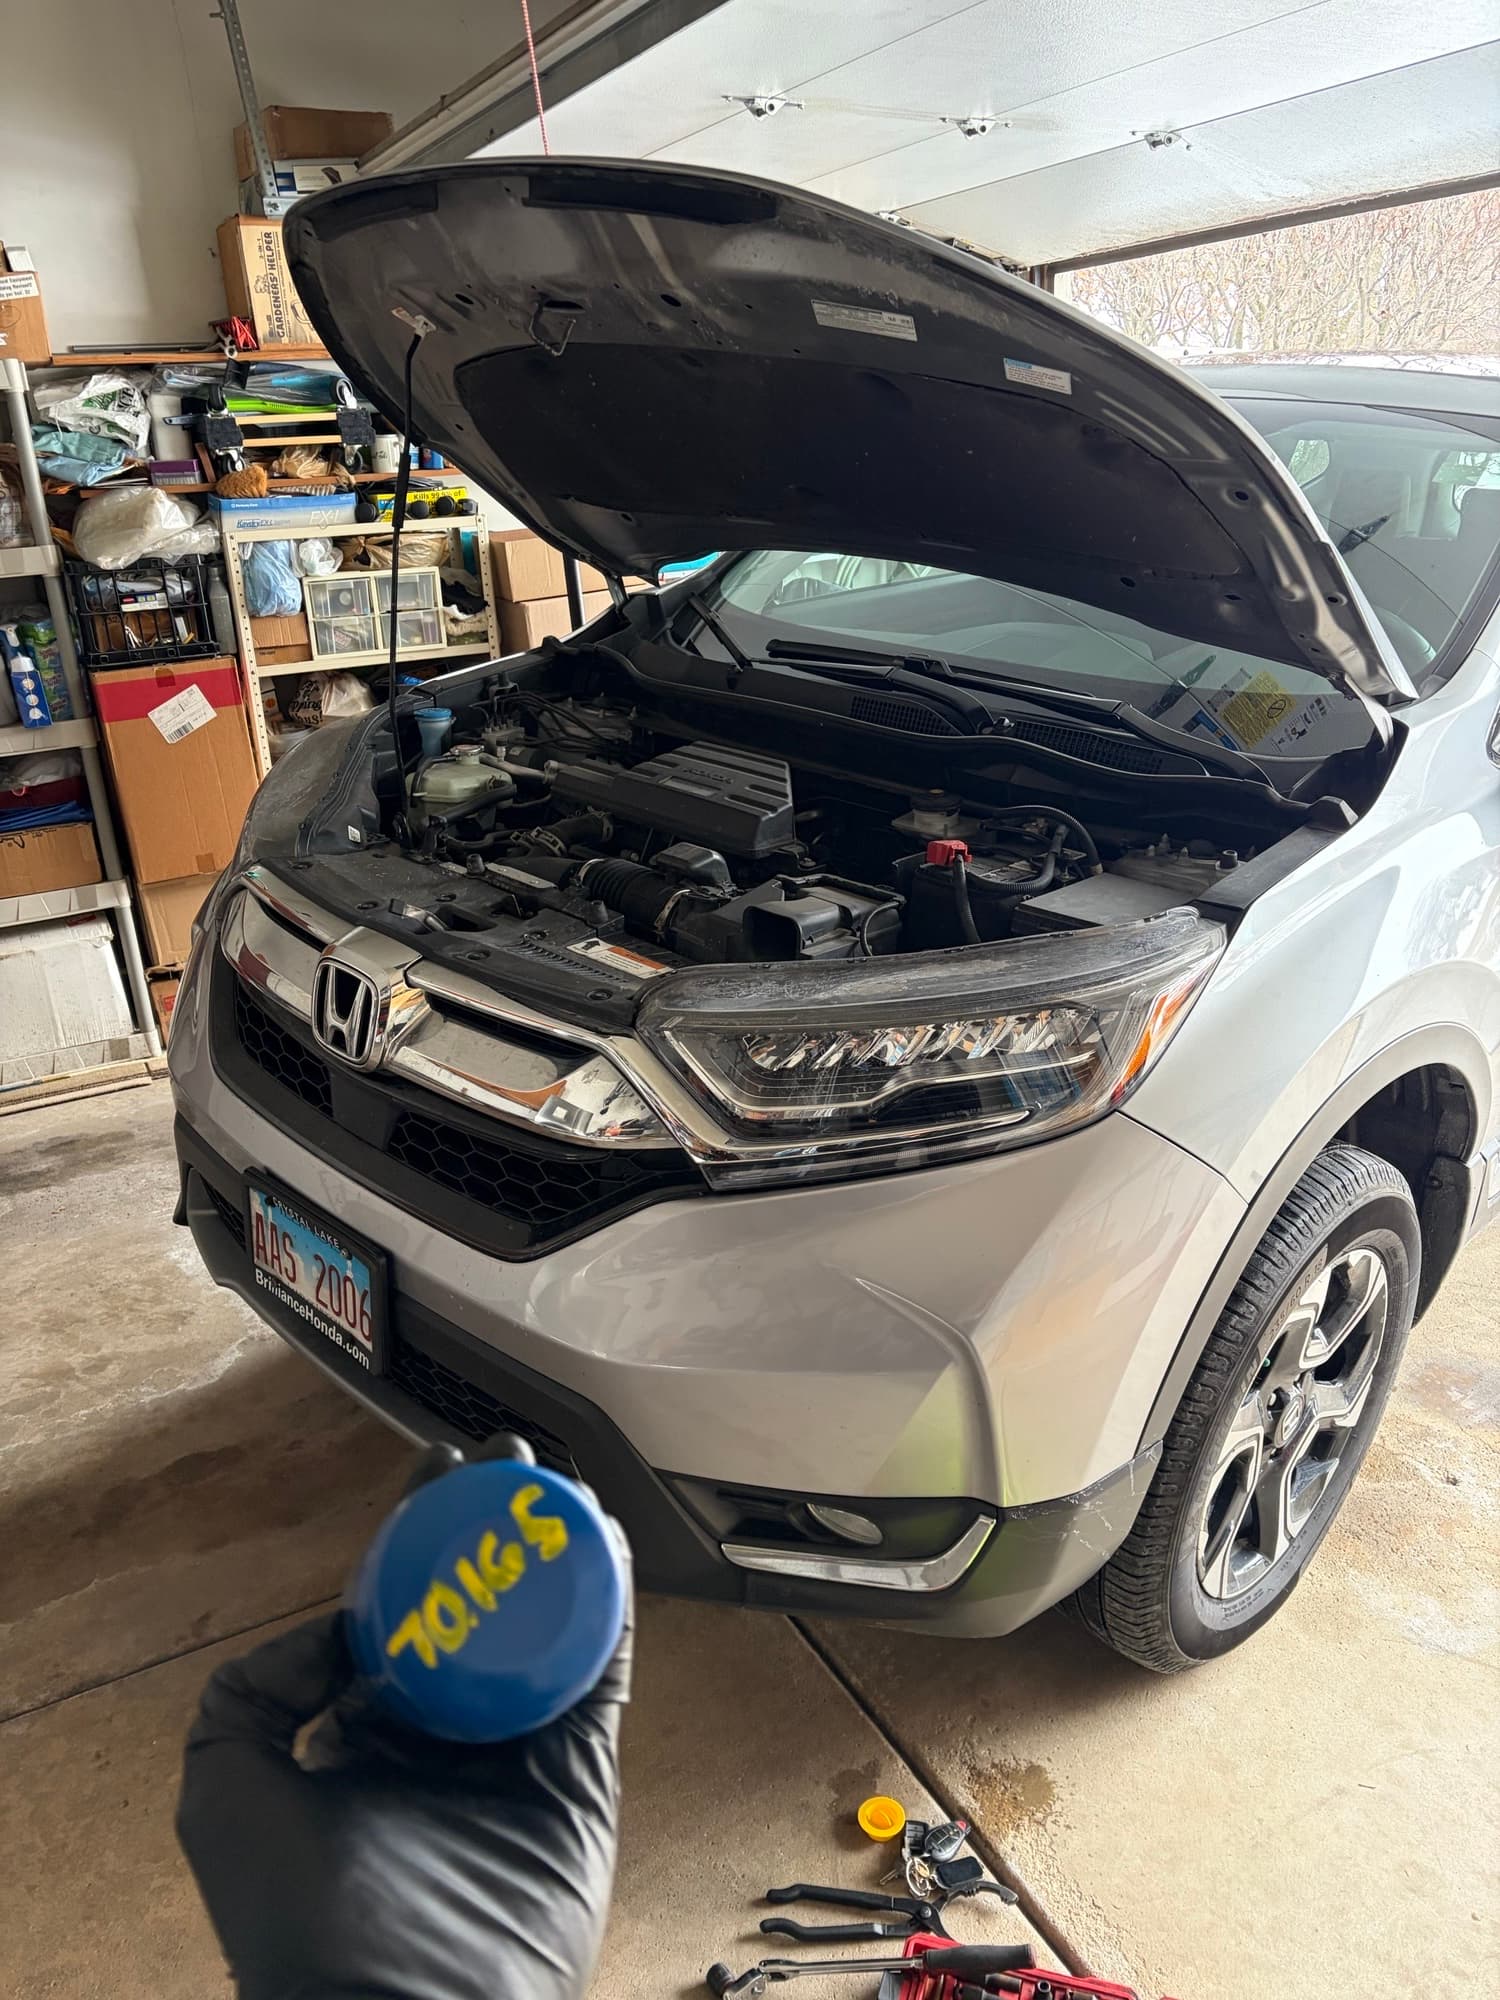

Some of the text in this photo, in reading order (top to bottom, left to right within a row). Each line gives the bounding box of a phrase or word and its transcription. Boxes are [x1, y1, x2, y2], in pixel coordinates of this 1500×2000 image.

[264, 231, 276, 271] HELPER
[272, 1196, 341, 1249] CRYSTAL LAKE
[254, 1212, 373, 1342] AAS 2006
